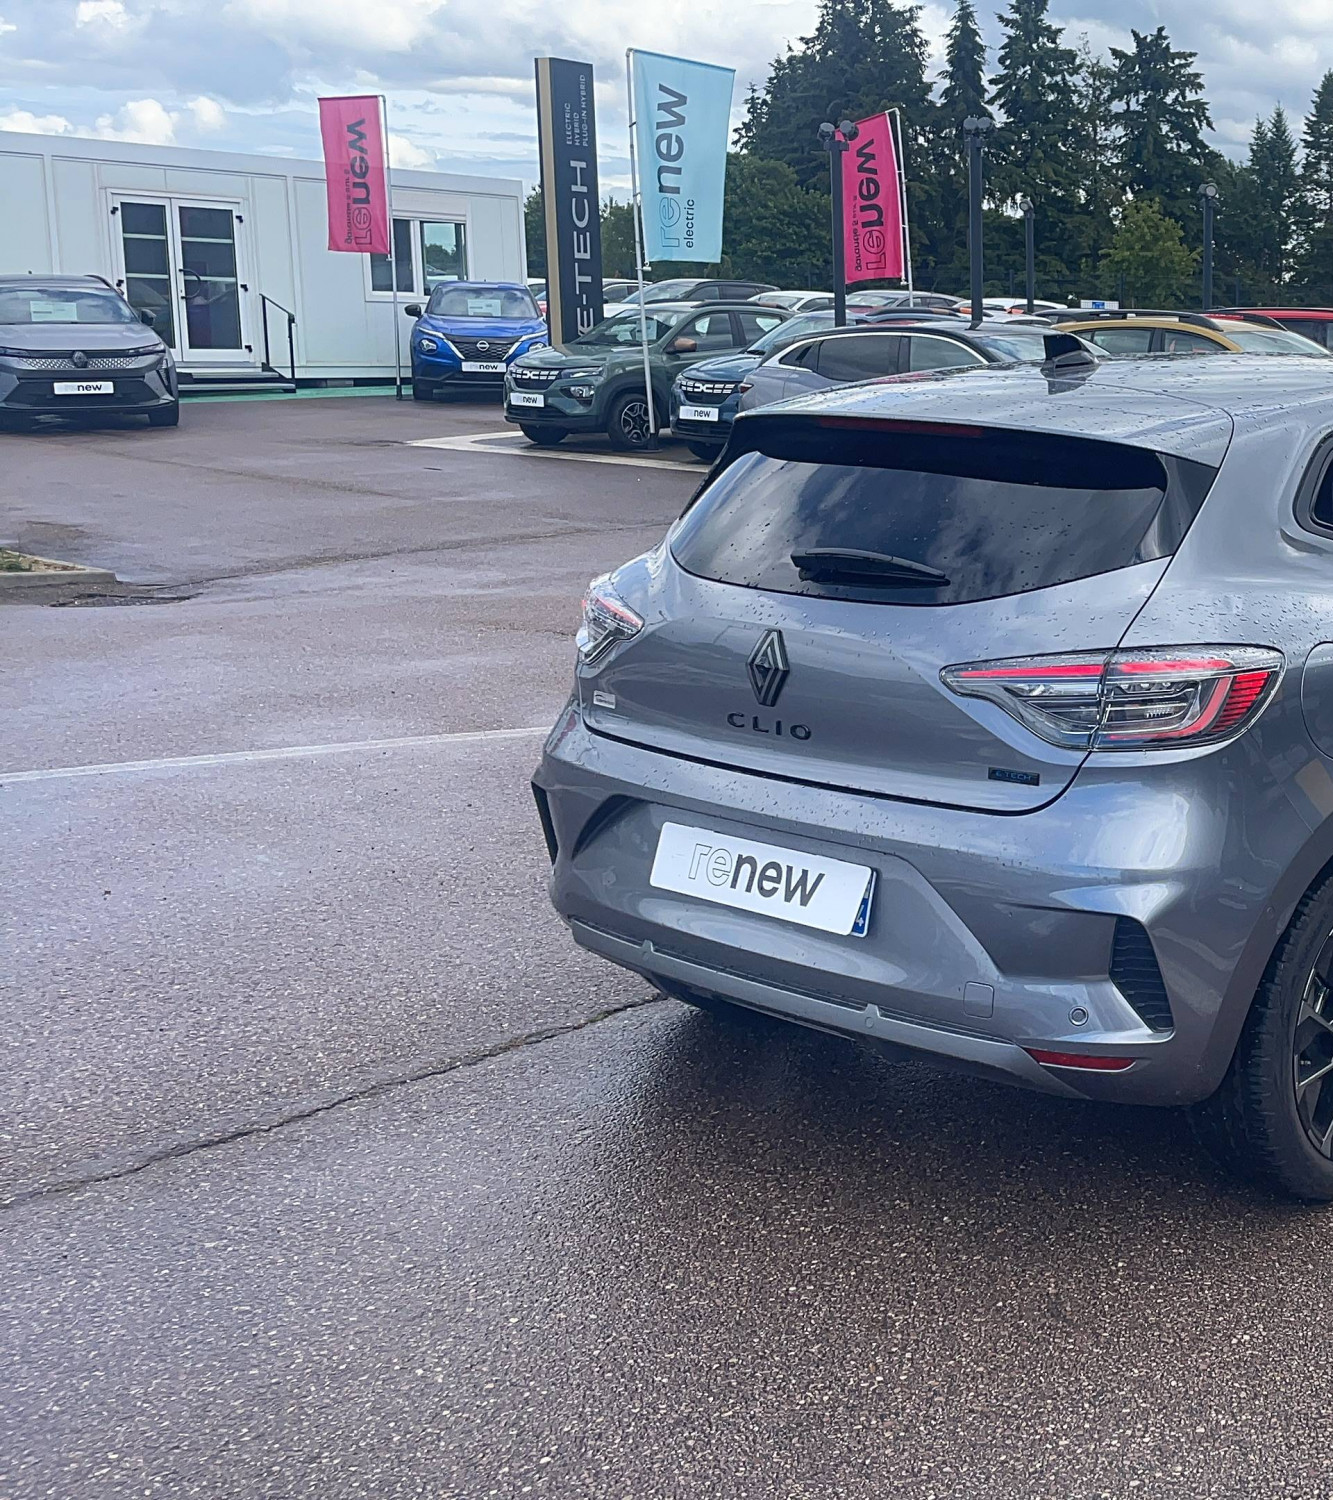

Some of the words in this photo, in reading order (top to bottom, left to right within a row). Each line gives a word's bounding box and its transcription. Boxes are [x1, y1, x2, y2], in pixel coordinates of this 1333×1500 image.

[564, 102, 572, 145] ELECTRIC
[655, 83, 688, 248] renew
[569, 159, 594, 337] E-TECH
[683, 198, 695, 249] electric
[727, 712, 812, 741] CLIO
[688, 843, 826, 907] renew
